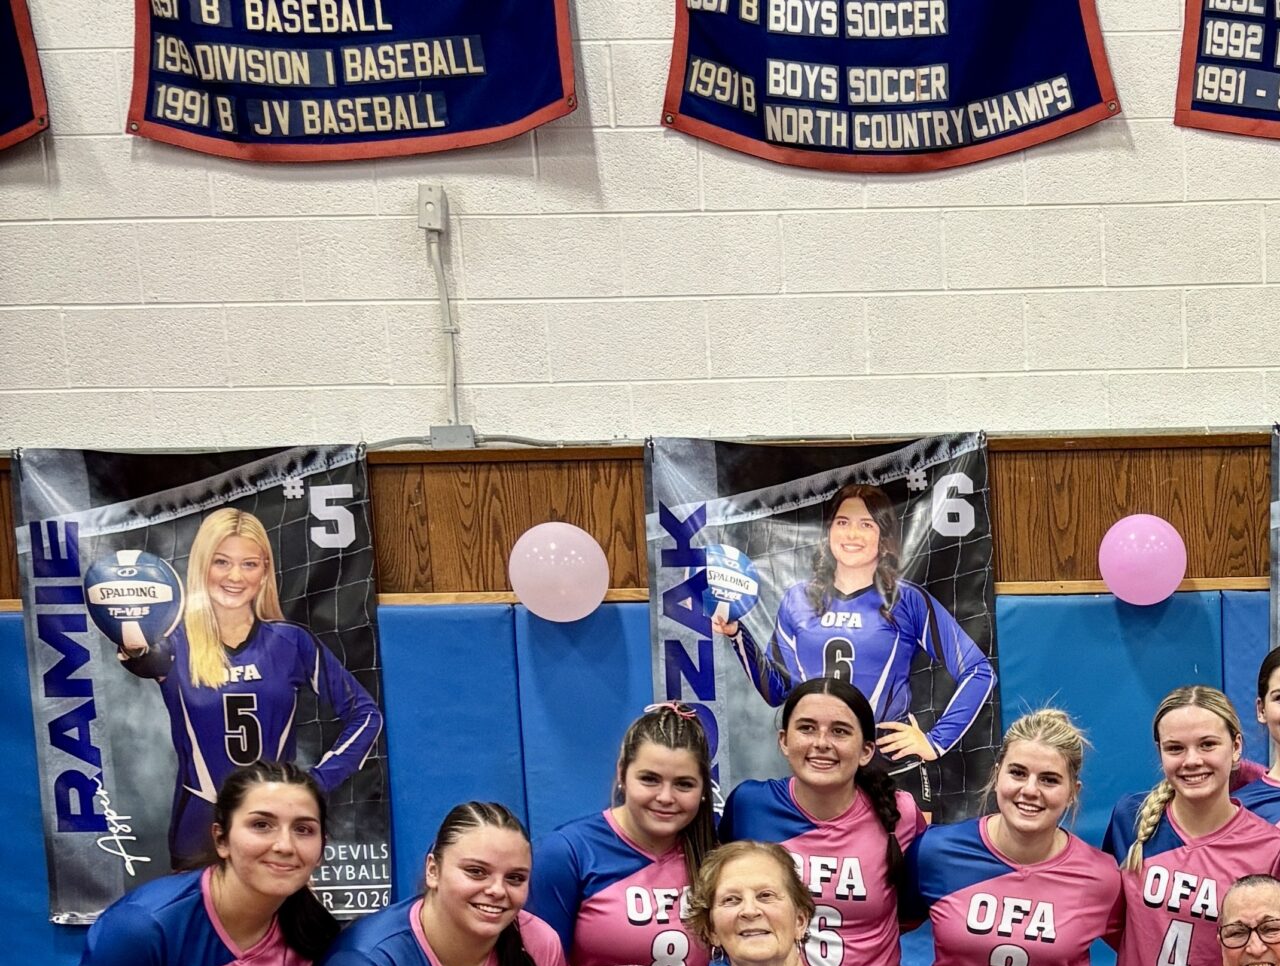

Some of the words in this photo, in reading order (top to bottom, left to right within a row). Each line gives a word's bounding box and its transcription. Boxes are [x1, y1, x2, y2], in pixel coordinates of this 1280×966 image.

[200, 0, 219, 24] B
[246, 0, 393, 33] BASEBALL
[767, 0, 838, 36] BOYS
[847, 1, 947, 37] SOCCER
[195, 44, 312, 86] DIVISION
[344, 38, 485, 83] BASEBALL
[1206, 22, 1262, 61] 1992
[689, 59, 740, 105] 1991
[742, 77, 756, 114] B
[768, 60, 838, 101] BOYS
[849, 66, 947, 104] SOCCER
[1197, 65, 1246, 103] 1991
[157, 84, 210, 126] 1991
[216, 96, 235, 132] B
[254, 100, 290, 136] JV
[303, 94, 446, 135] BASEBALL
[765, 108, 848, 147] NORTH
[854, 109, 966, 150] COUNTRY
[969, 79, 1072, 139] CHAMPS
[282, 475, 358, 550] #5
[906, 469, 976, 538] #6
[100, 586, 159, 601] SPALDING
[708, 569, 751, 591] SPALDING
[820, 612, 862, 629] OFA
[30, 520, 107, 833] RAMIE
[229, 663, 263, 683] FA
[222, 691, 263, 767] 5
[324, 843, 389, 861] DEVILS
[344, 891, 389, 908] 2026
[1143, 864, 1219, 921] OFA
[966, 891, 1058, 943] OFA
